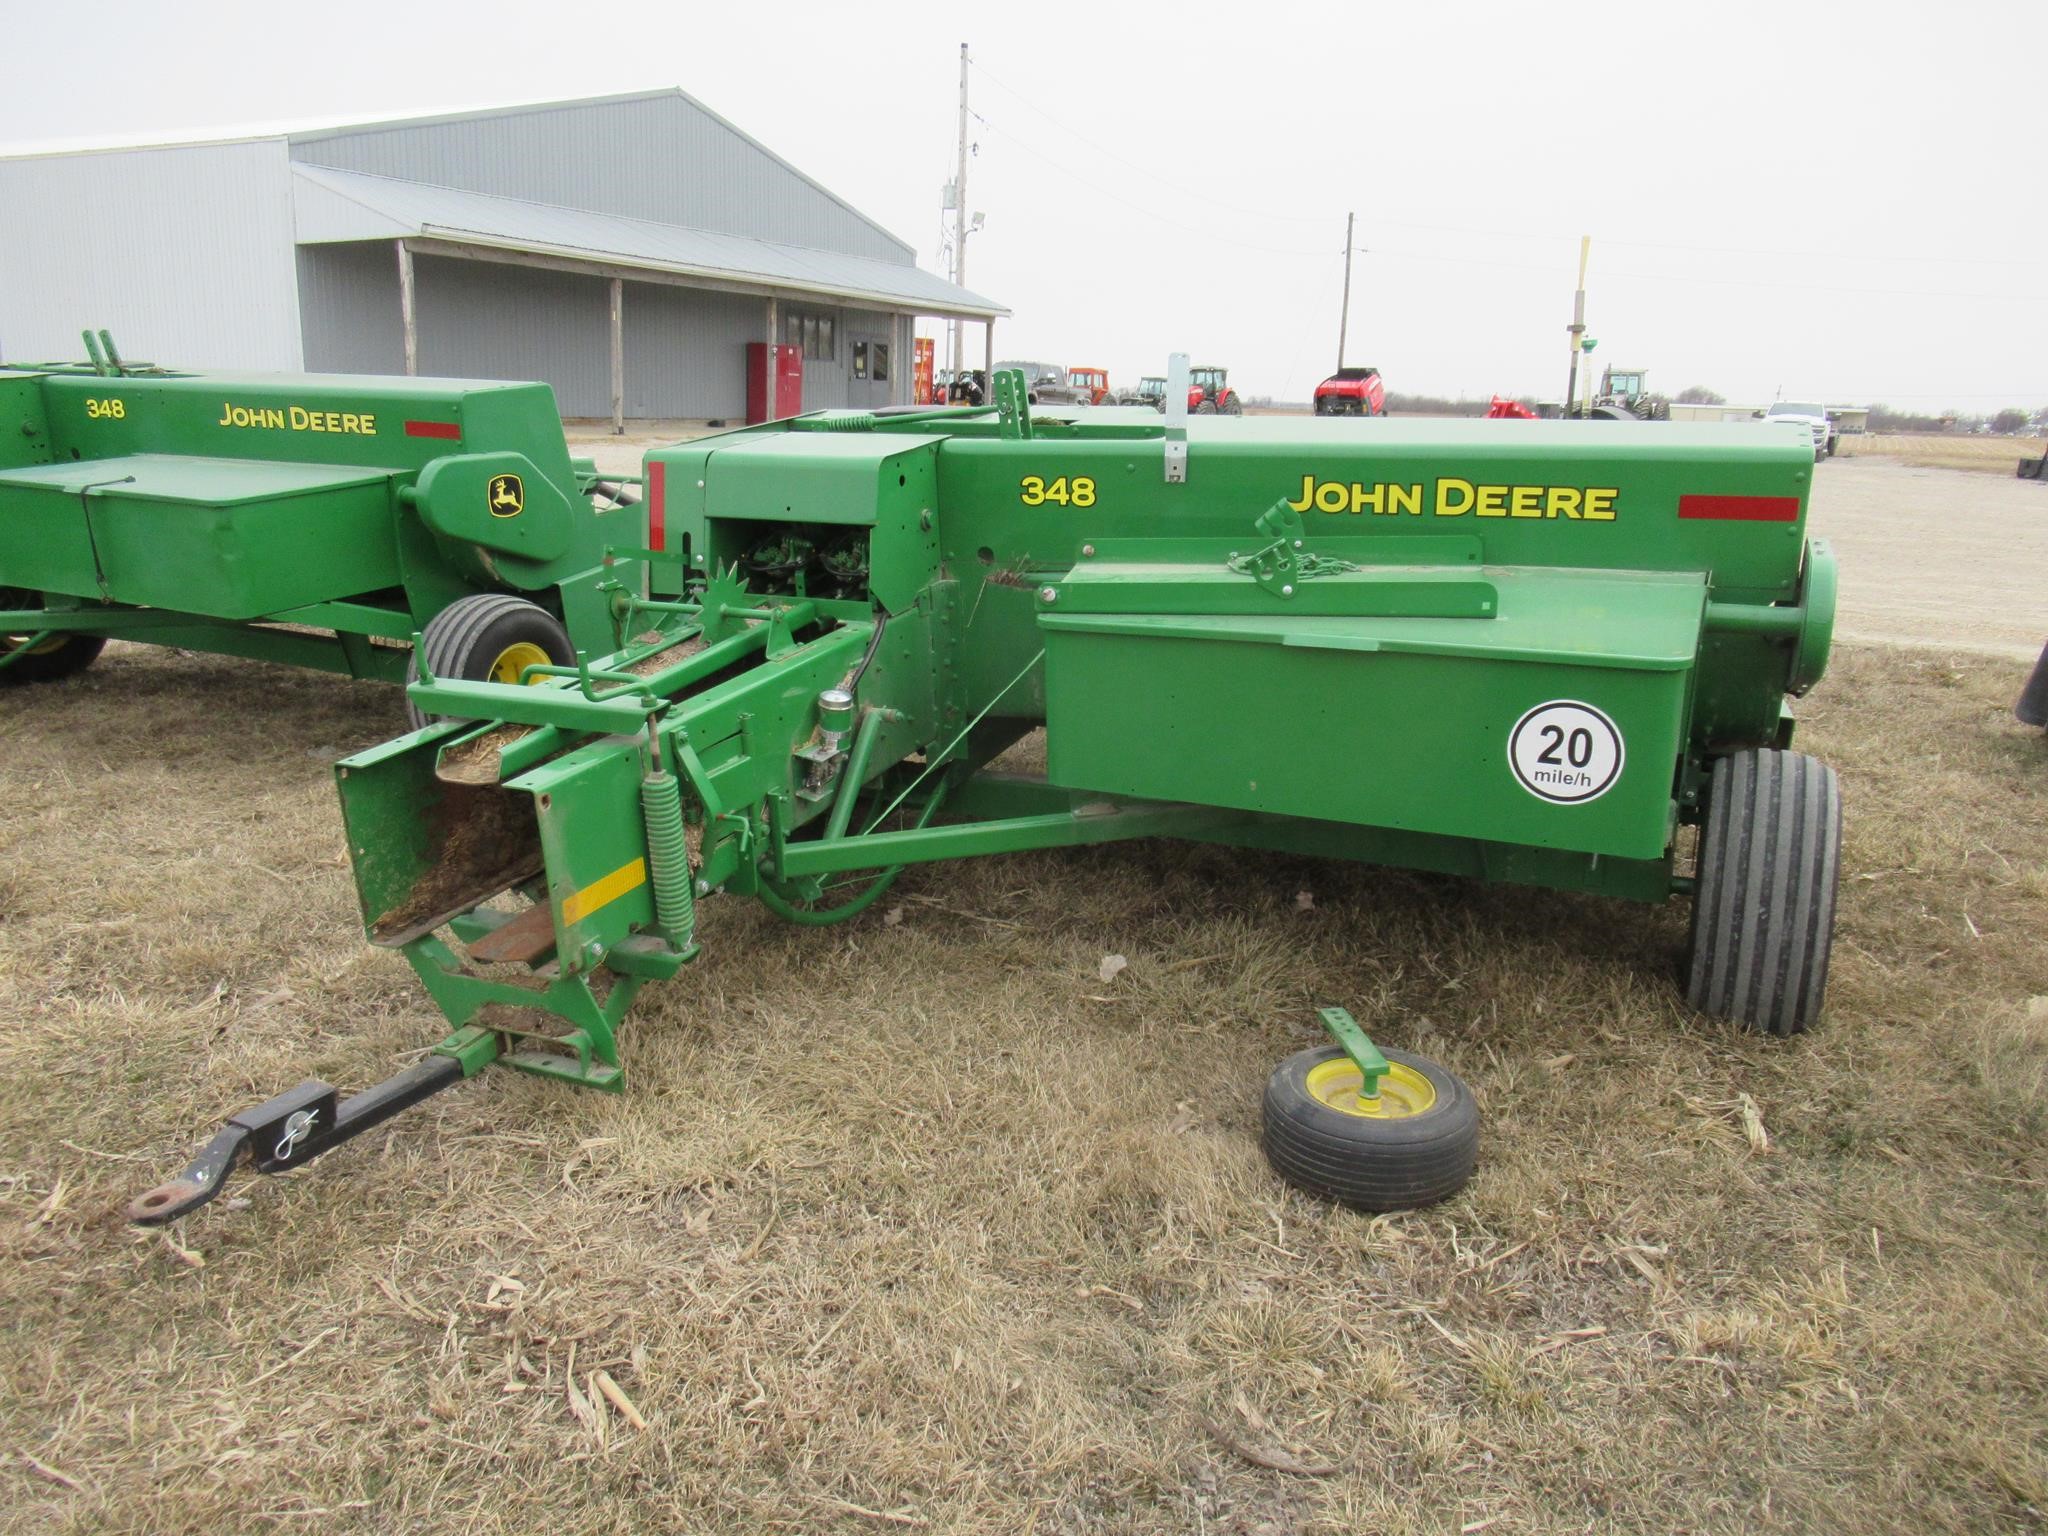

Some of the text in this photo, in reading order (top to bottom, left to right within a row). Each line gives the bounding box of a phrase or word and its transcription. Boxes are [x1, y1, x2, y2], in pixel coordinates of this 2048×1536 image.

[86, 399, 125, 419] 348
[219, 403, 377, 435] JOHN DEERE
[1021, 476, 1096, 507] 348
[1288, 476, 1618, 520] JOHN DEERE
[1537, 724, 1593, 768] 20
[1534, 769, 1592, 787] mile/h
